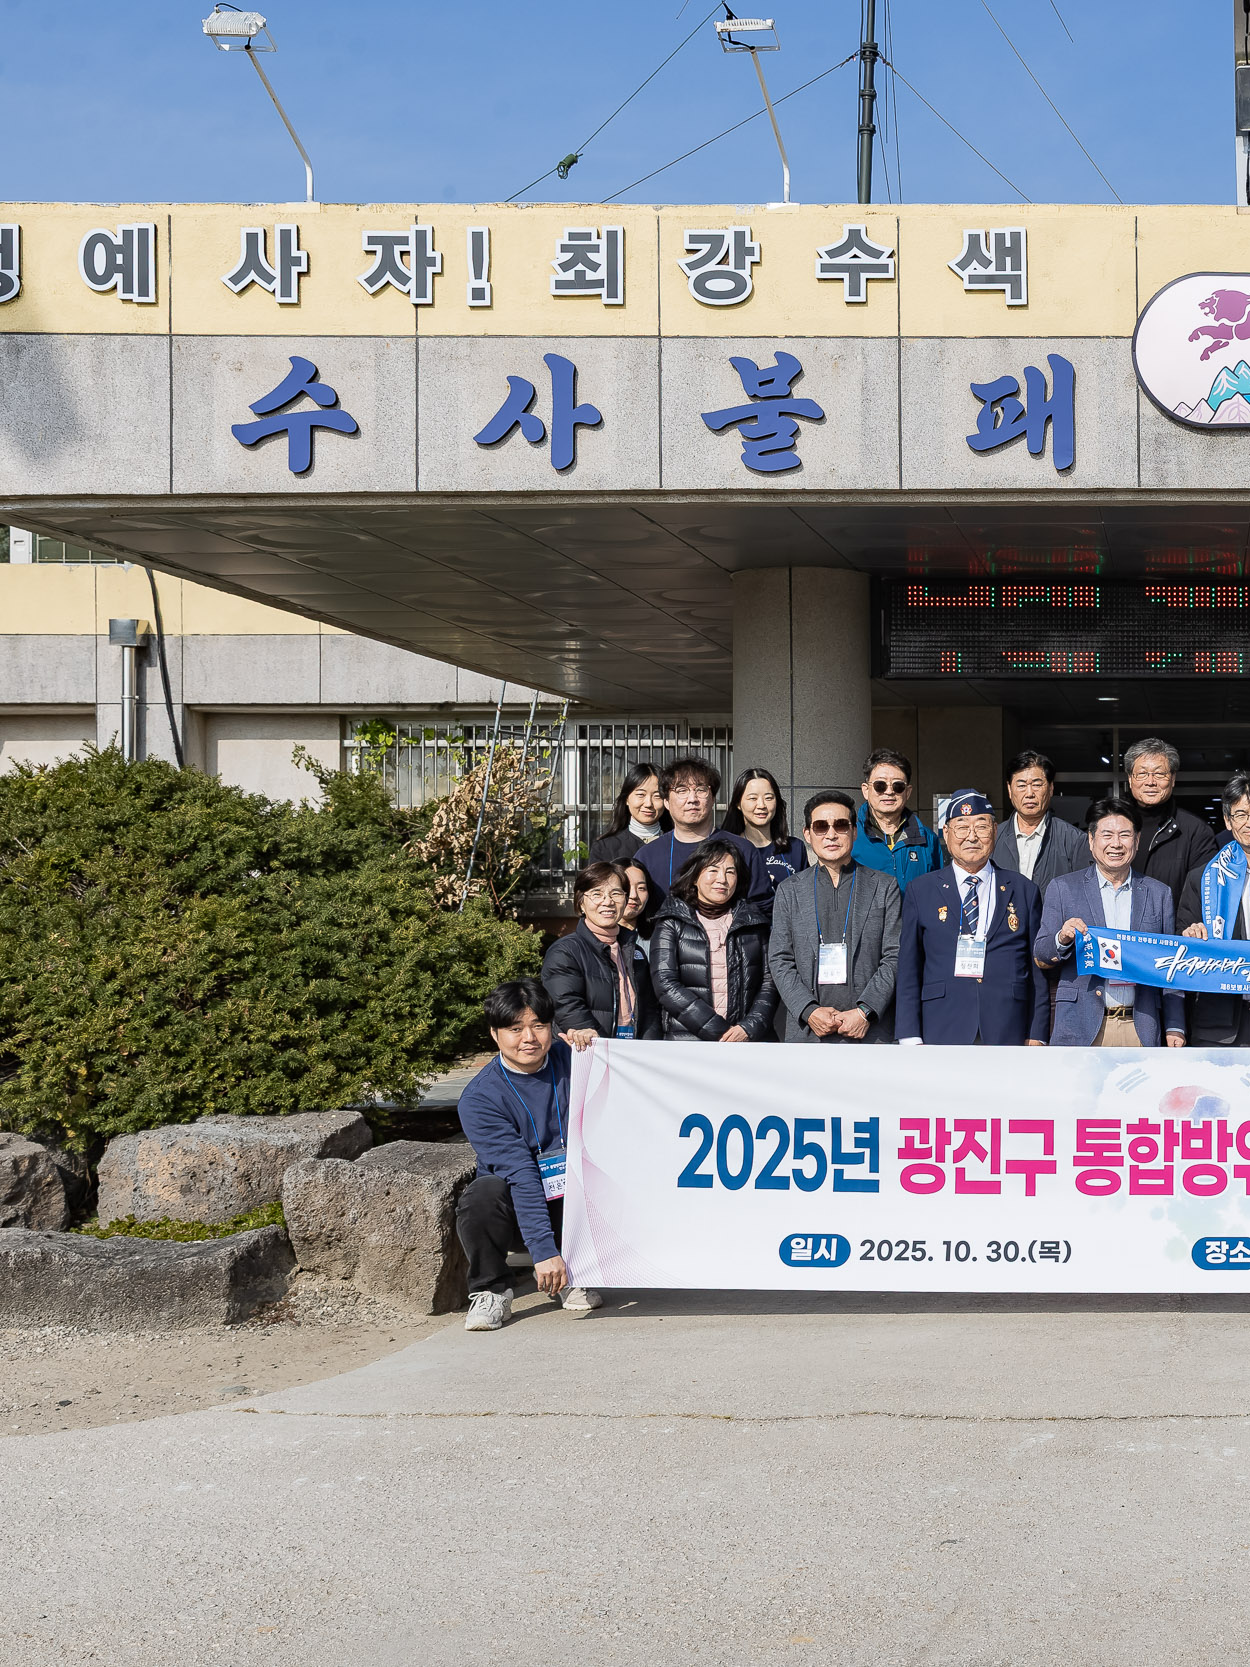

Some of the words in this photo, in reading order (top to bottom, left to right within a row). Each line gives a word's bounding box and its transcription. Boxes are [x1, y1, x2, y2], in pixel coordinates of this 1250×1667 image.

[677, 1113, 880, 1193] 2025년
[897, 1117, 1057, 1197] 광진구
[790, 1237, 838, 1262] 일시
[859, 1239, 934, 1263] 2025.
[942, 1240, 978, 1263] 10.
[985, 1239, 1072, 1264] 30.(목)
